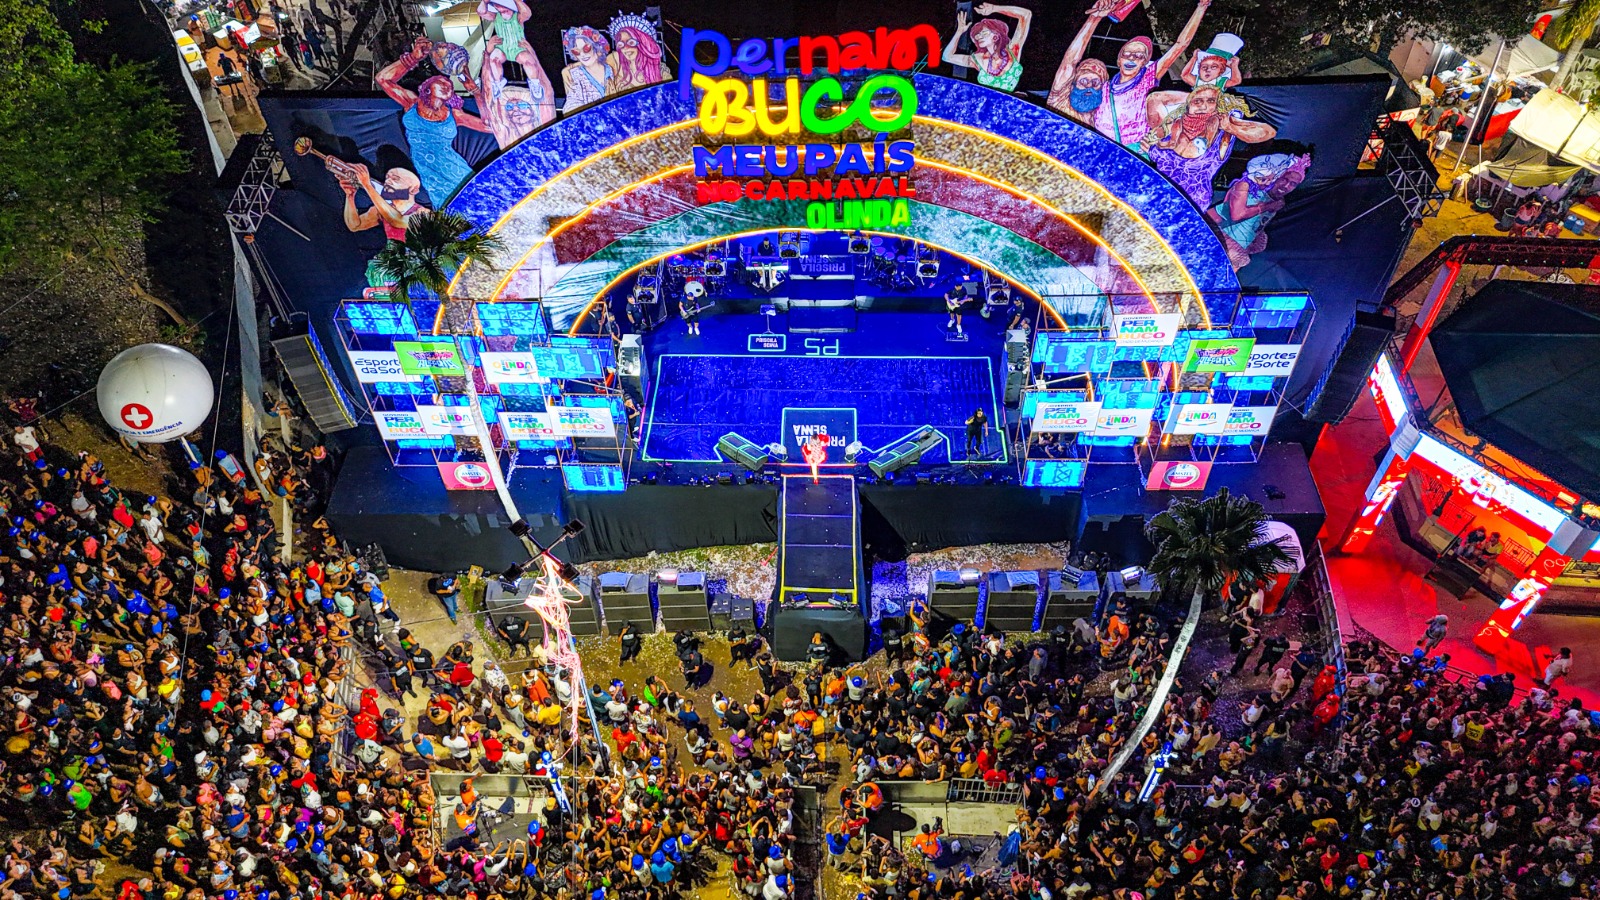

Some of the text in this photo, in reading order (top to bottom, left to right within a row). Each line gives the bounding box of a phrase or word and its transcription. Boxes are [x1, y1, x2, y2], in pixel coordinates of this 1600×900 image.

[693, 133, 915, 177] MEU PAÍS
[697, 176, 916, 203] NO CARNAVAL
[806, 199, 911, 229] OLINDA
[801, 263, 846, 272] PRISCILA
[354, 358, 401, 367] Esport
[492, 360, 533, 372] OLINDA
[431, 413, 471, 424] OLINDA
[1098, 415, 1137, 426] OLINDA
[1177, 410, 1217, 422] OLINDA
[142, 421, 183, 435] EMERGÊNCIA
[792, 424, 828, 436] SENNA
[795, 435, 846, 447] PRIILA
